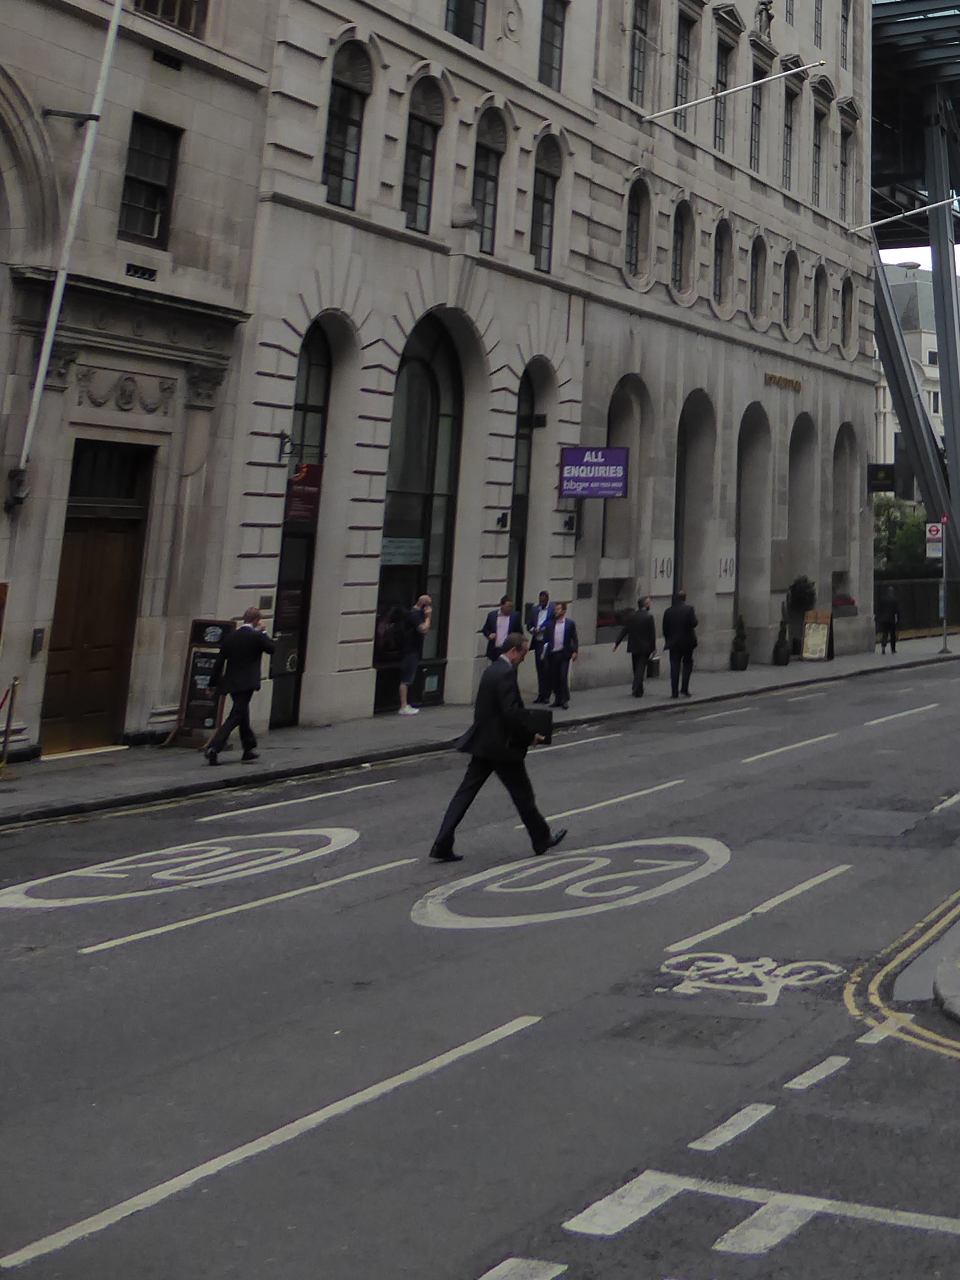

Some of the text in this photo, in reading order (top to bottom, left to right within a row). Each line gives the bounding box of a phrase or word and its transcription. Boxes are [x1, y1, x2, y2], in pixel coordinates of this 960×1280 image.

[583, 450, 605, 463] ALL
[563, 465, 624, 477] ENQUIRIES
[653, 557, 673, 579] 140
[718, 557, 734, 578] 140
